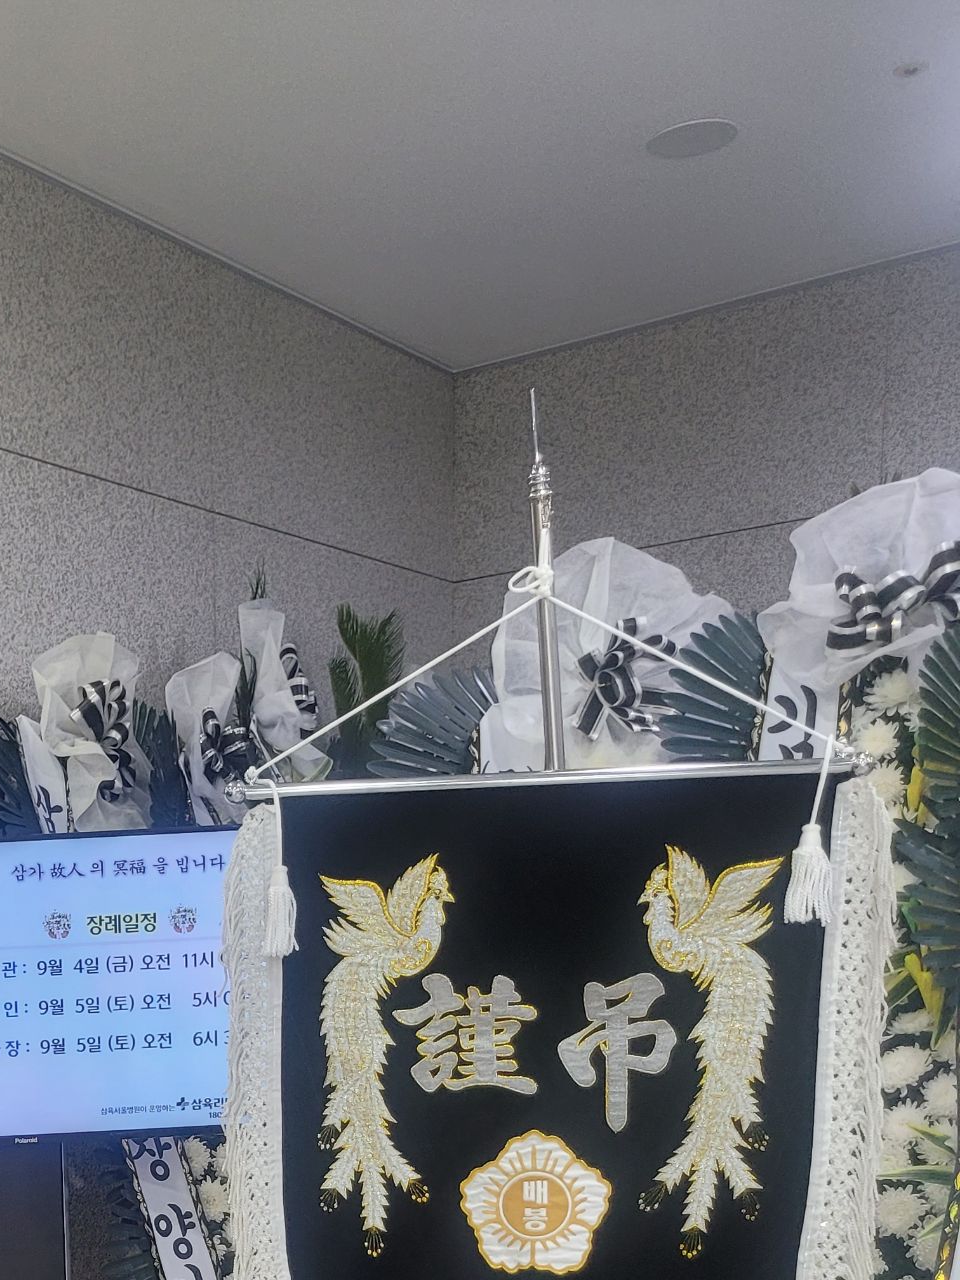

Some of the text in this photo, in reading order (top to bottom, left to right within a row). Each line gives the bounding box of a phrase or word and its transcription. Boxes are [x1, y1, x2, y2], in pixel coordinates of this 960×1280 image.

[11, 863, 44, 882] 삼가
[176, 854, 226, 872] 빕니다
[86, 912, 157, 936] 장례일정
[37, 958, 63, 976] 9월
[73, 957, 100, 975] 4일
[105, 955, 134, 974] (금)
[140, 953, 171, 970] 오전
[182, 951, 215, 968] 11시
[38, 998, 65, 1016] 9월
[75, 996, 100, 1014] 5일
[107, 995, 135, 1012] (토)
[140, 993, 172, 1010] 오전
[192, 991, 218, 1008] 5시
[40, 1037, 66, 1055] 9월
[76, 1036, 102, 1053] 5일
[108, 1033, 136, 1051] (토)
[141, 1032, 173, 1049] 오전
[193, 1029, 219, 1046] 6시
[191, 1097, 228, 1111] 삼육리
[15, 1136, 38, 1144] Polaroid
